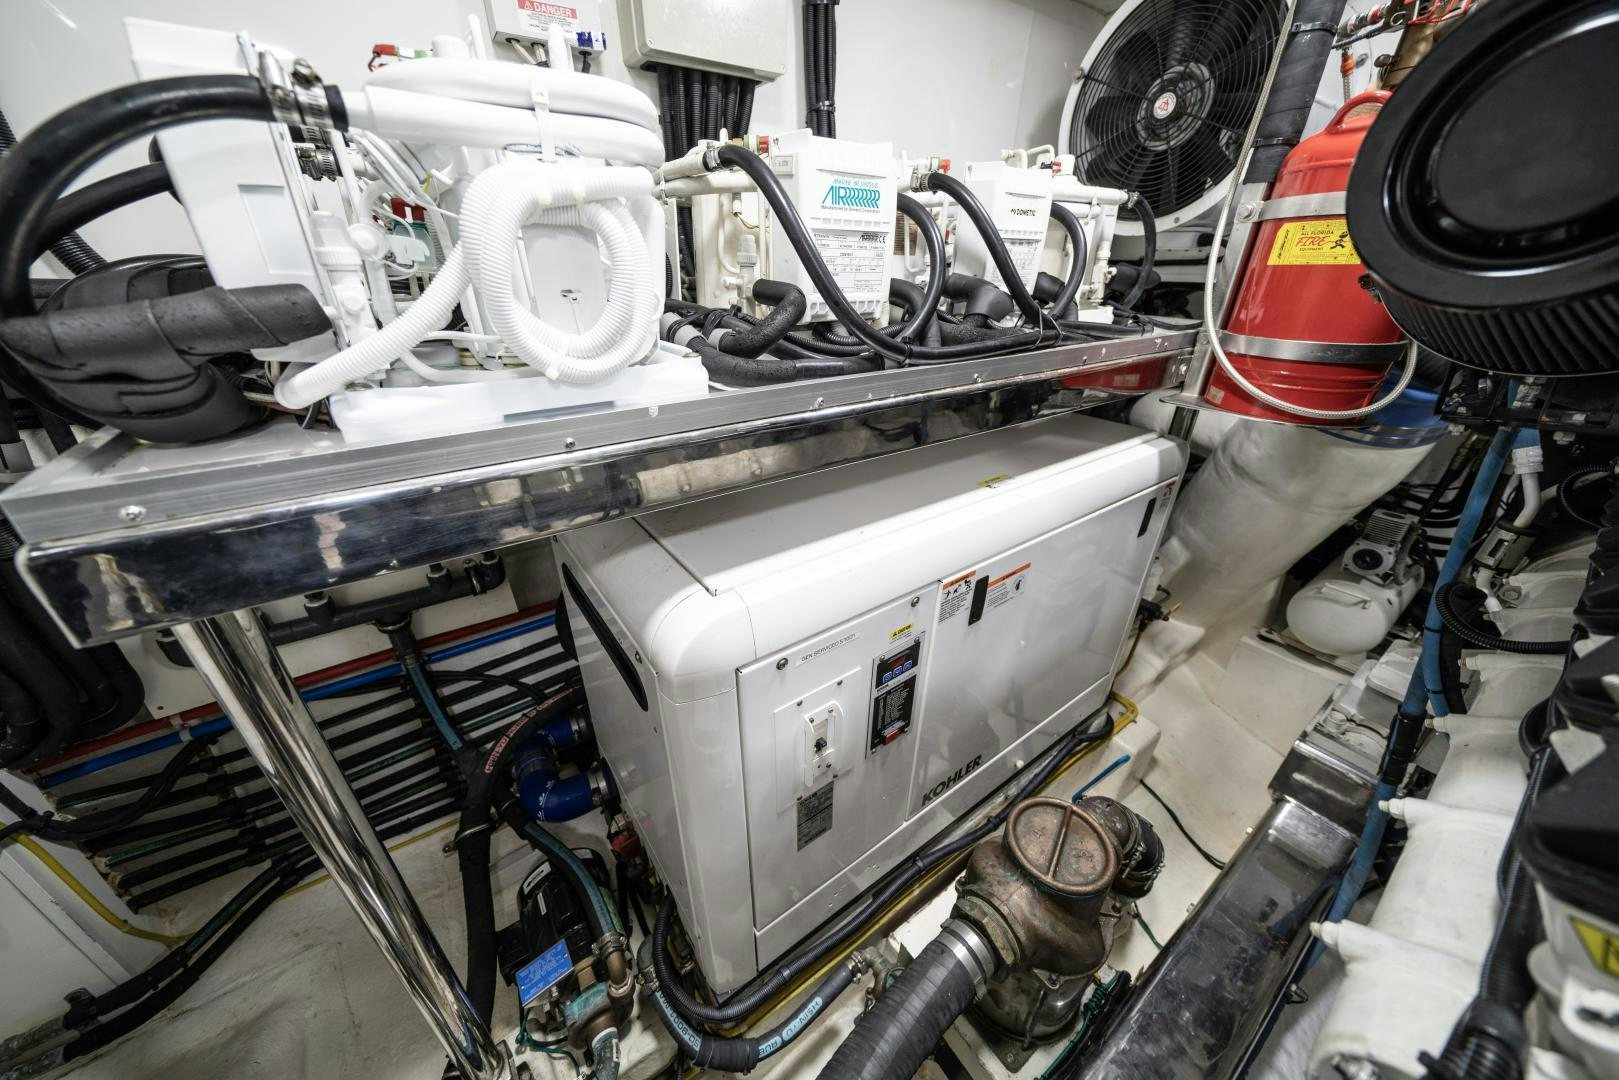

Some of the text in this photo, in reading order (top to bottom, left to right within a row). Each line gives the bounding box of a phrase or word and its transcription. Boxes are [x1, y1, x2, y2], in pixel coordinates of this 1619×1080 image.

[534, 3, 573, 17] DANGER
[1016, 208, 1036, 217] DOMETIC
[1296, 235, 1330, 247] FIRE
[922, 754, 982, 807] KOHLER
